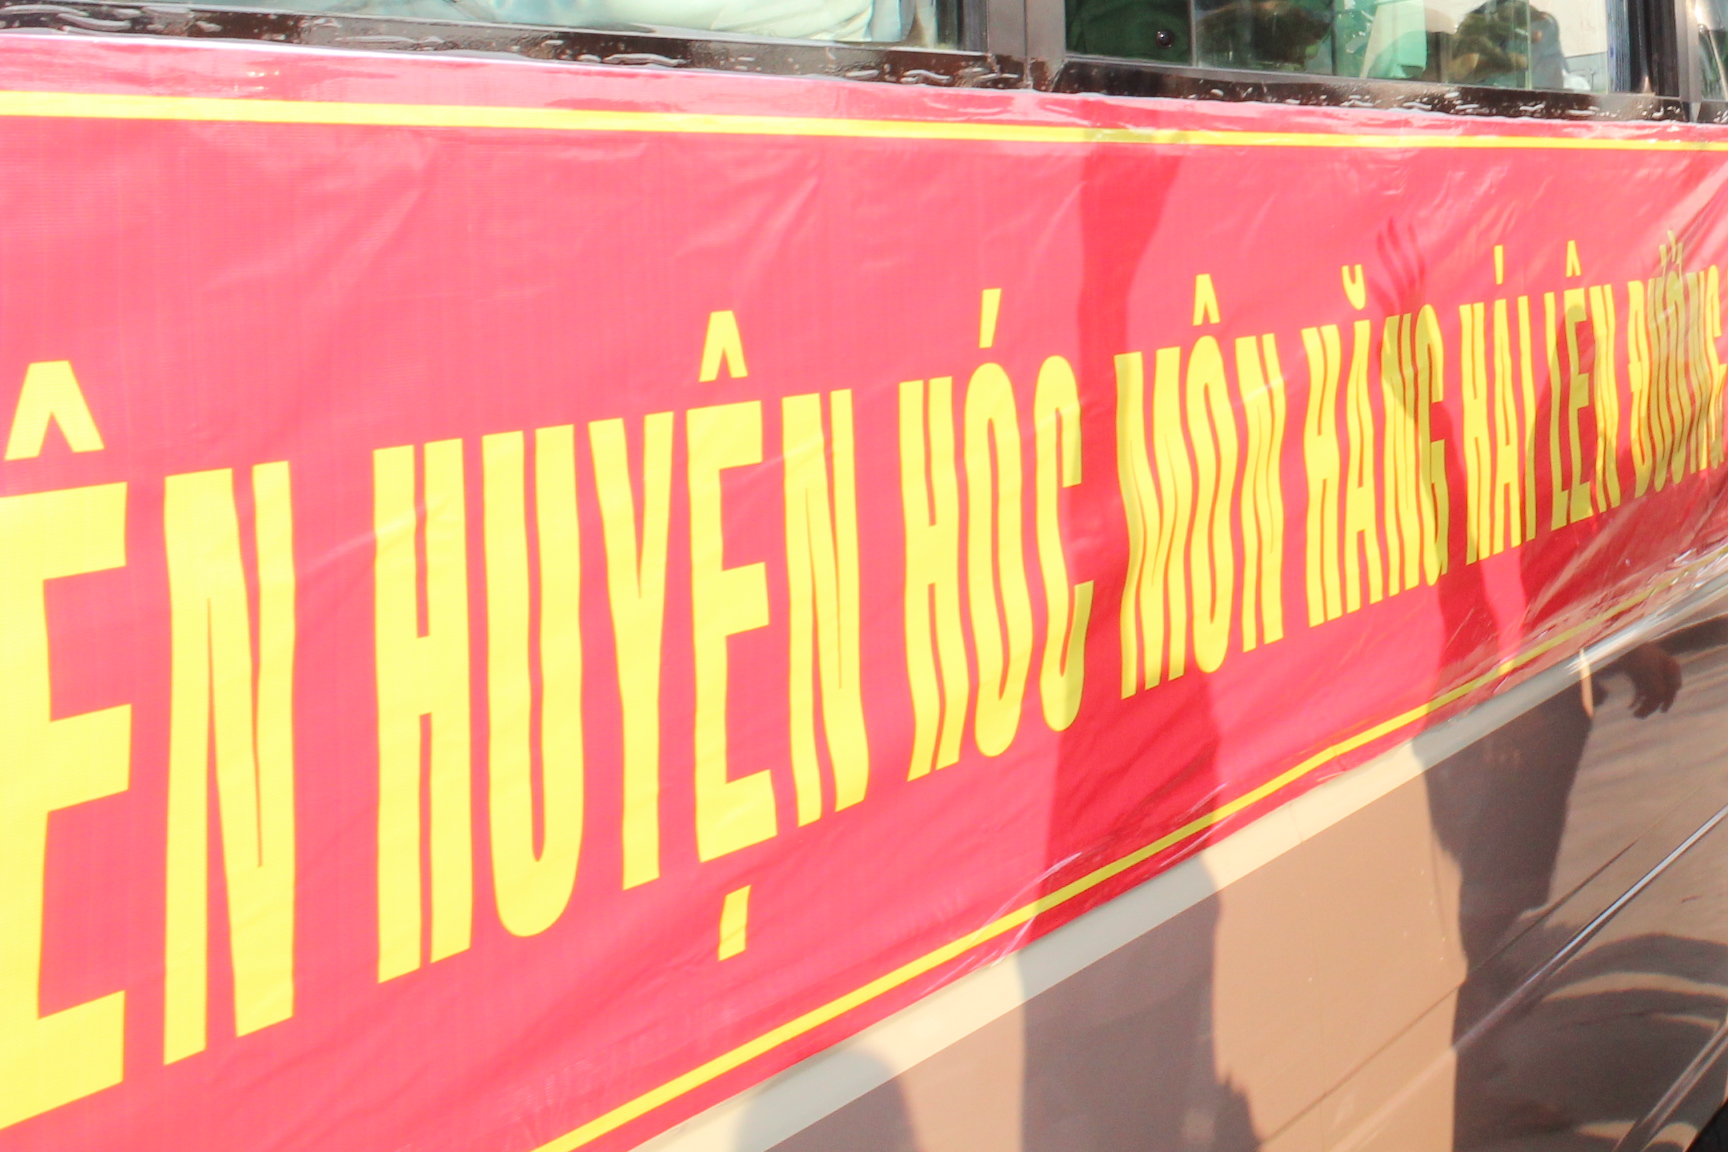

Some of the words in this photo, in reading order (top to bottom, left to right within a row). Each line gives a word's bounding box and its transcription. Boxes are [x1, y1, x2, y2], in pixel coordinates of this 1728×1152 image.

[373, 310, 869, 983] HUYỆN
[899, 288, 1095, 782] HÓC
[1114, 274, 1286, 698] MÔN
[1302, 264, 1450, 626] HĂNG
[1459, 245, 1537, 564] HÁI
[1544, 240, 1621, 530] LÊN
